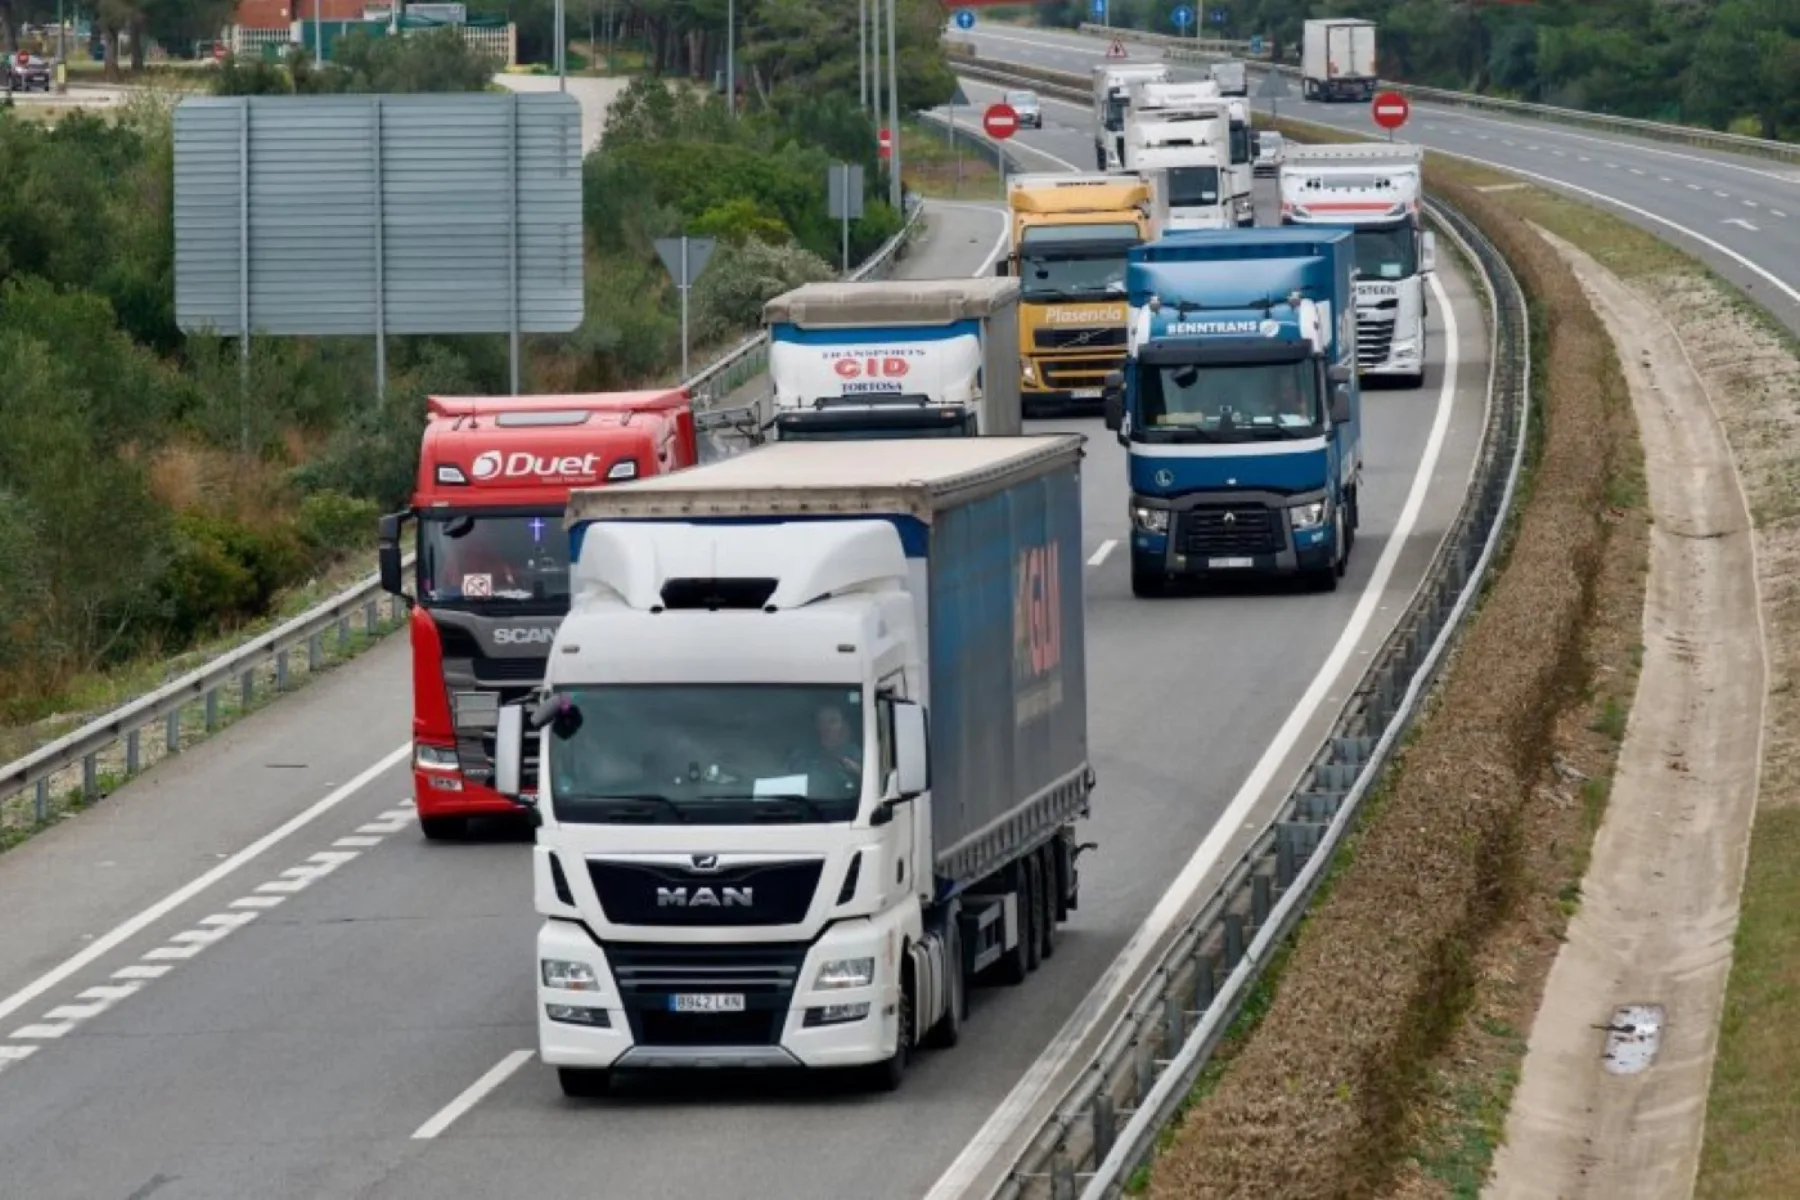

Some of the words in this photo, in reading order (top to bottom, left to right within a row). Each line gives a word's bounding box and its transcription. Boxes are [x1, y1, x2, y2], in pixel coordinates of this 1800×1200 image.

[1046, 306, 1122, 323] Plasencia
[834, 358, 909, 378] CID
[841, 381, 903, 393] TORTOSA
[505, 451, 601, 477] Duet
[656, 886, 753, 907] MAN
